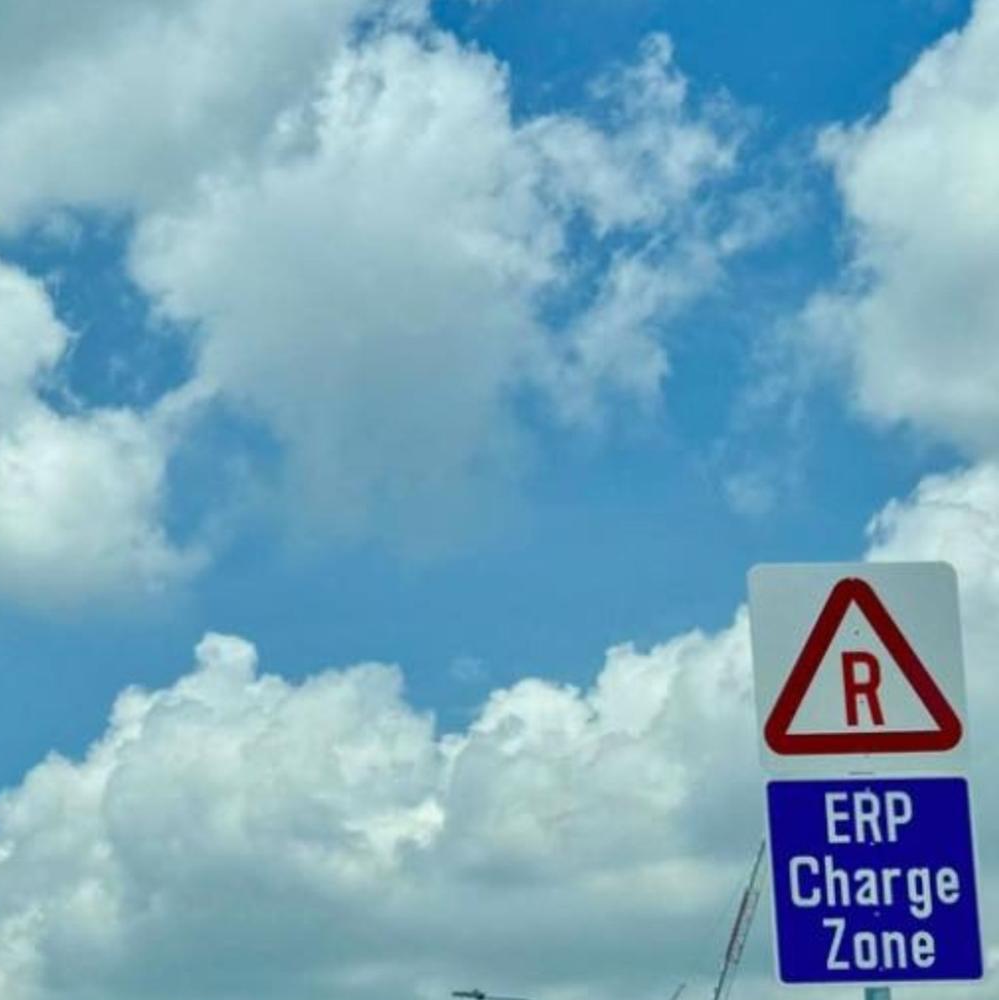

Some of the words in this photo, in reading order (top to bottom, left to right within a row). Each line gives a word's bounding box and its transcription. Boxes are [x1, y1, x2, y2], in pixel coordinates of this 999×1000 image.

[841, 651, 885, 727] R
[824, 790, 914, 845] ERP
[788, 854, 961, 920] Charge
[822, 917, 937, 971] Zone
